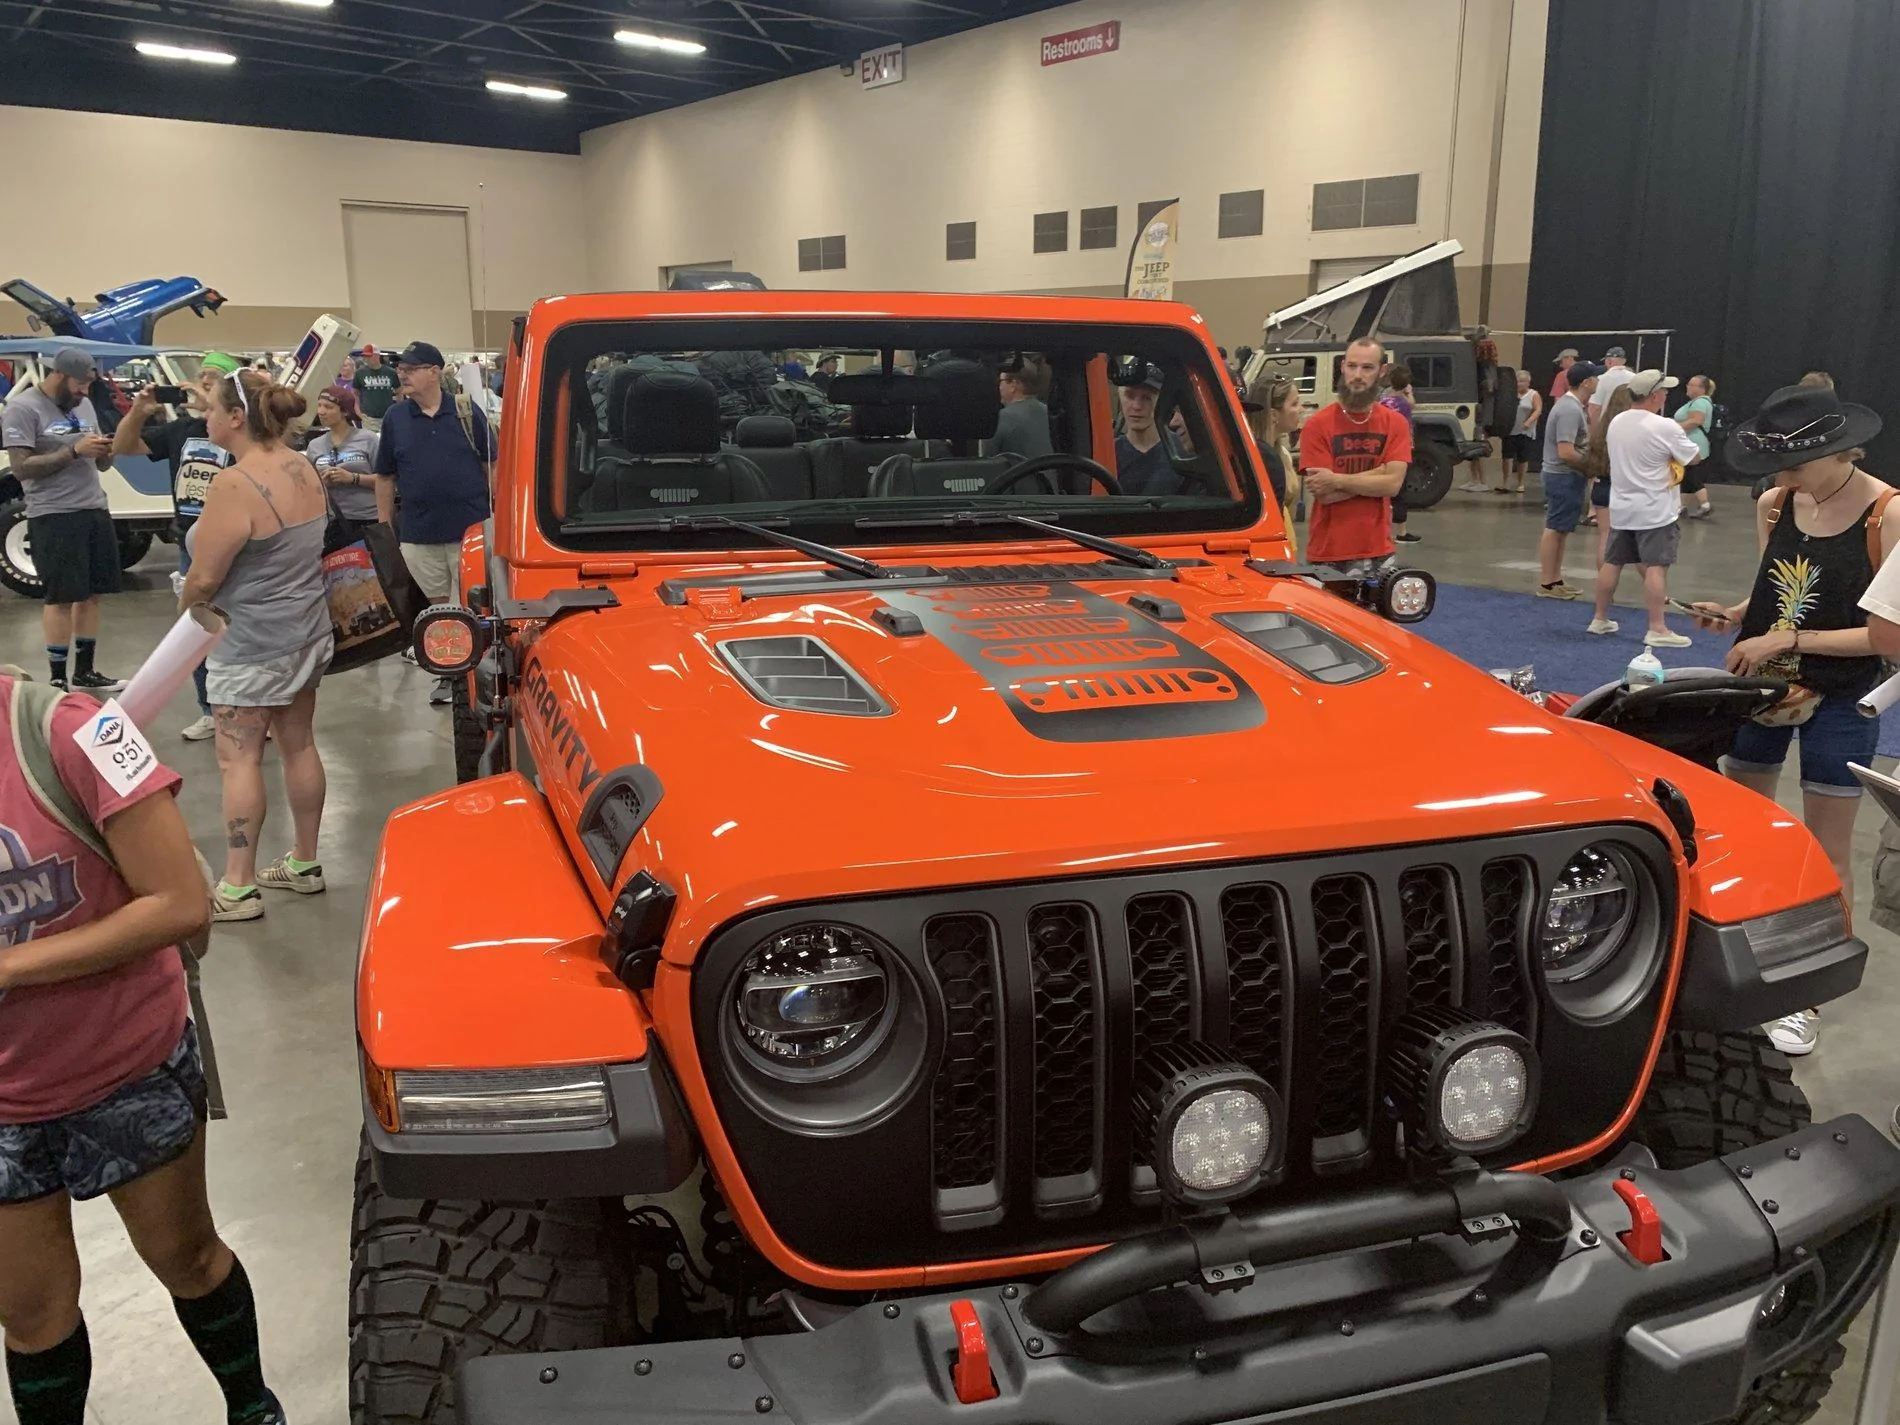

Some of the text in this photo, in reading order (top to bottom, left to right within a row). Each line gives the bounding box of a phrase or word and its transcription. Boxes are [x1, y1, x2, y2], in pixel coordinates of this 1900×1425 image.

[1043, 33, 1104, 61] Restrooms
[861, 50, 901, 84] EXIT
[1143, 261, 1170, 279] JEEP
[99, 721, 121, 742] DANA
[525, 656, 602, 794] GRAVITY
[0, 871, 54, 915] ON
